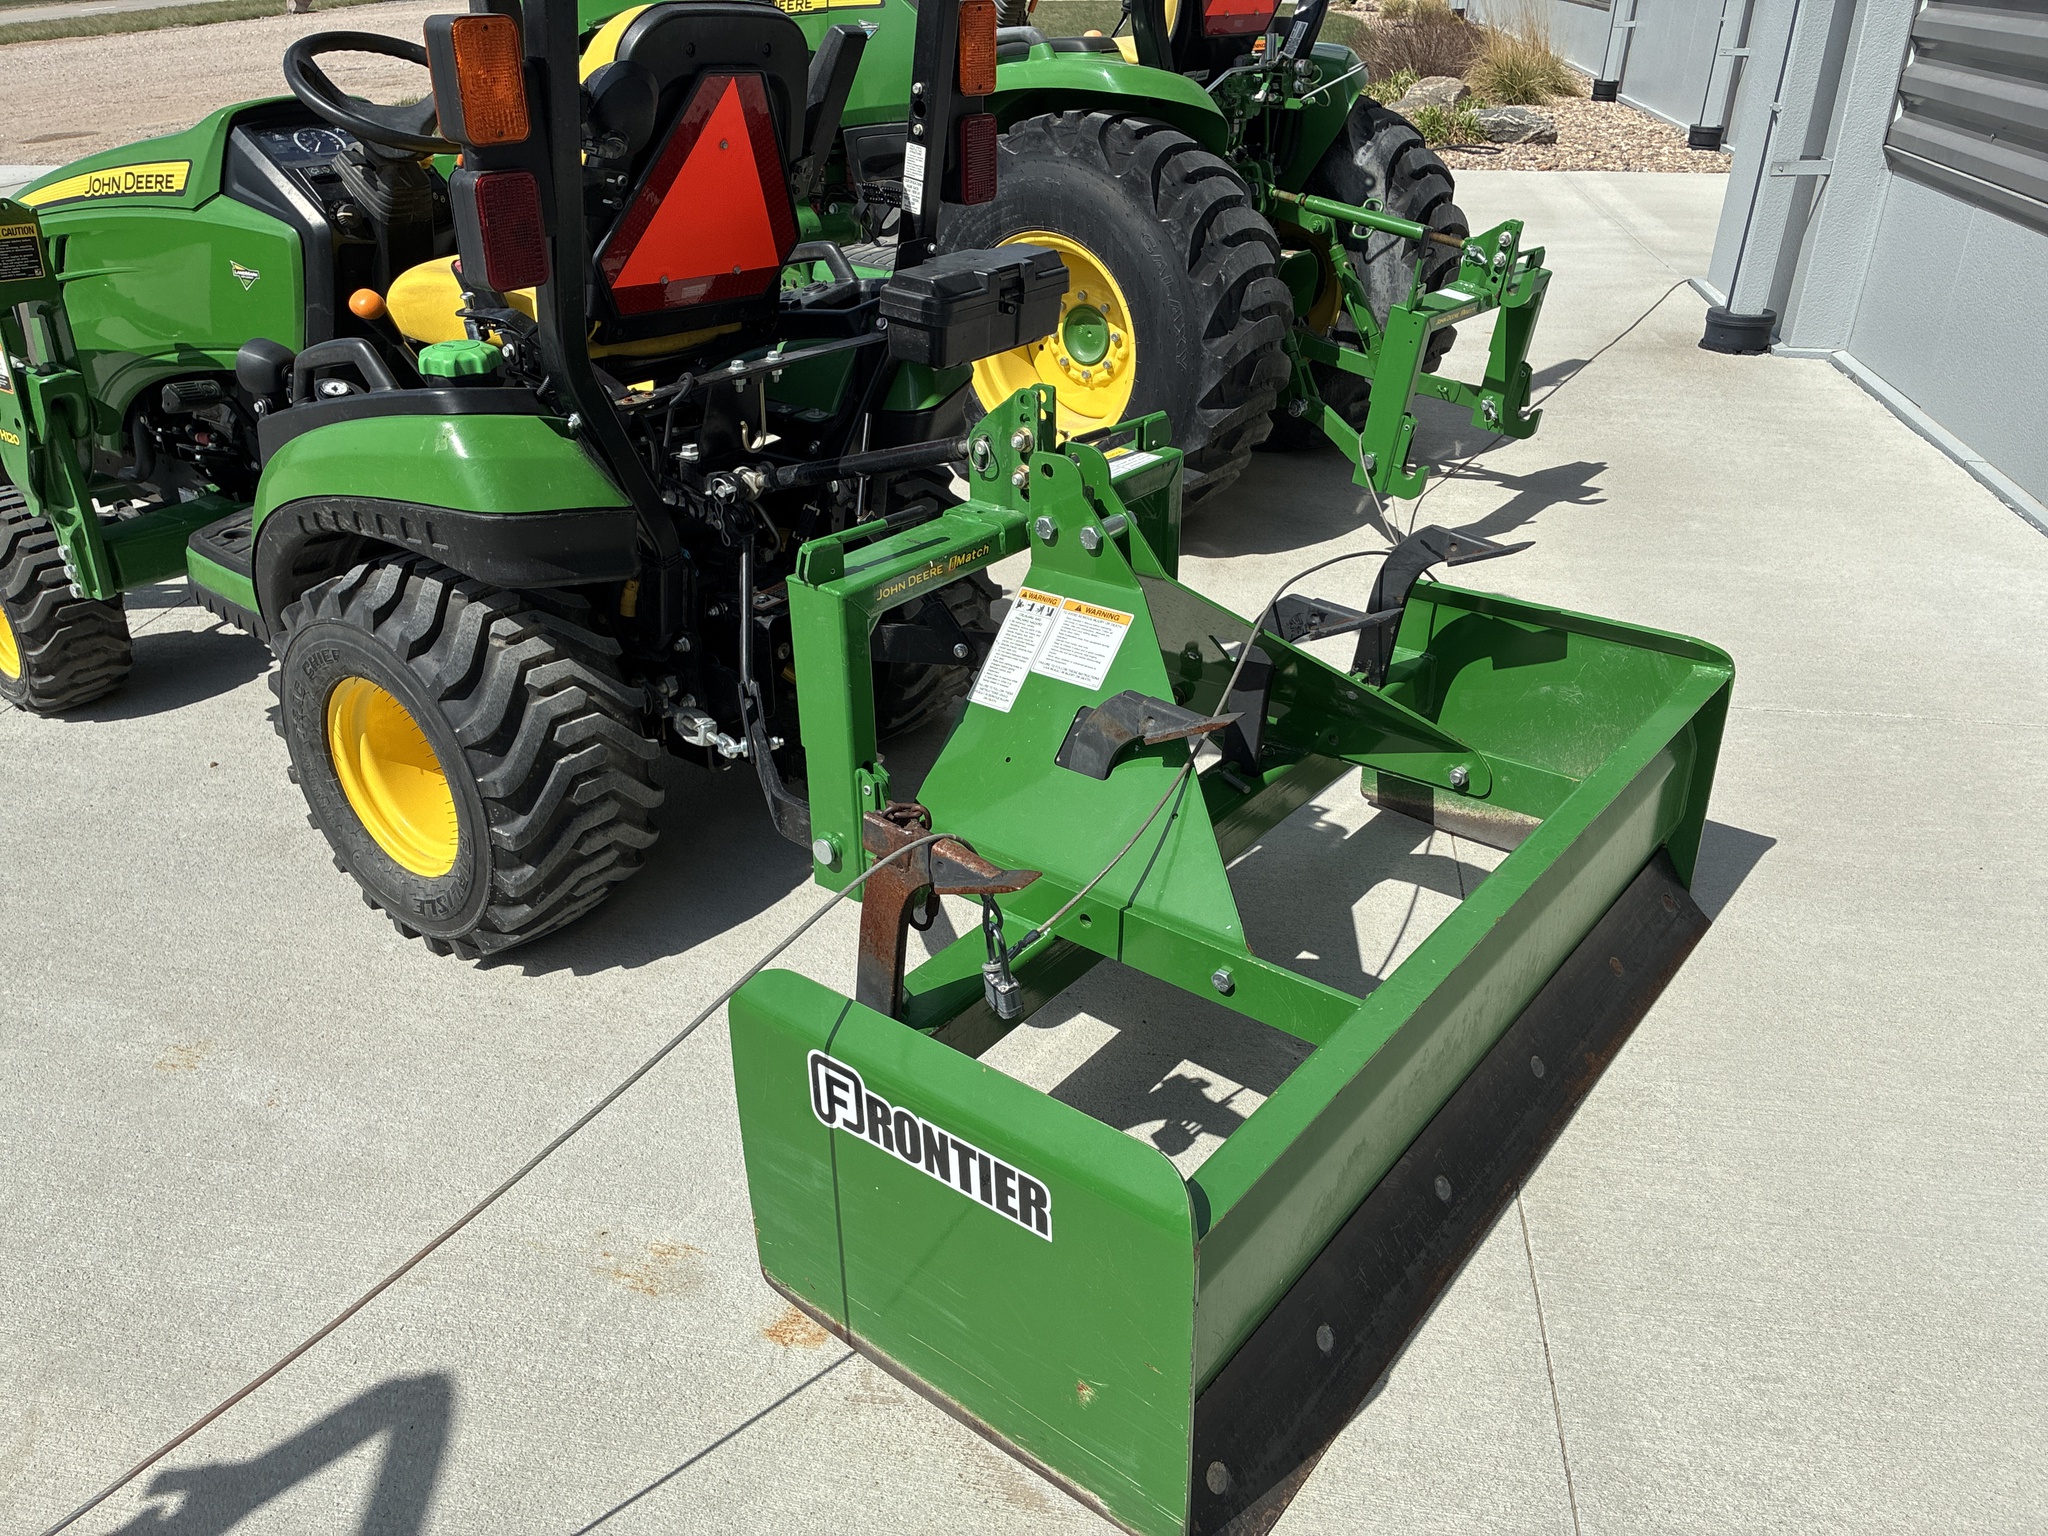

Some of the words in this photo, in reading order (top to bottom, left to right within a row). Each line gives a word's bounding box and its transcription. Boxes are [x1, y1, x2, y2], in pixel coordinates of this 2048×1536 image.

[85, 176, 121, 194] JOHN
[124, 172, 175, 190] DEERE
[1, 226, 35, 237] CAUTION
[1141, 232, 1188, 370] GALAXY
[876, 580, 906, 601] JOHN
[908, 565, 944, 587] DEERE
[1028, 592, 1058, 605] WARNING
[1085, 606, 1120, 621] WARNING
[810, 1053, 1050, 1237] FRONTIER
